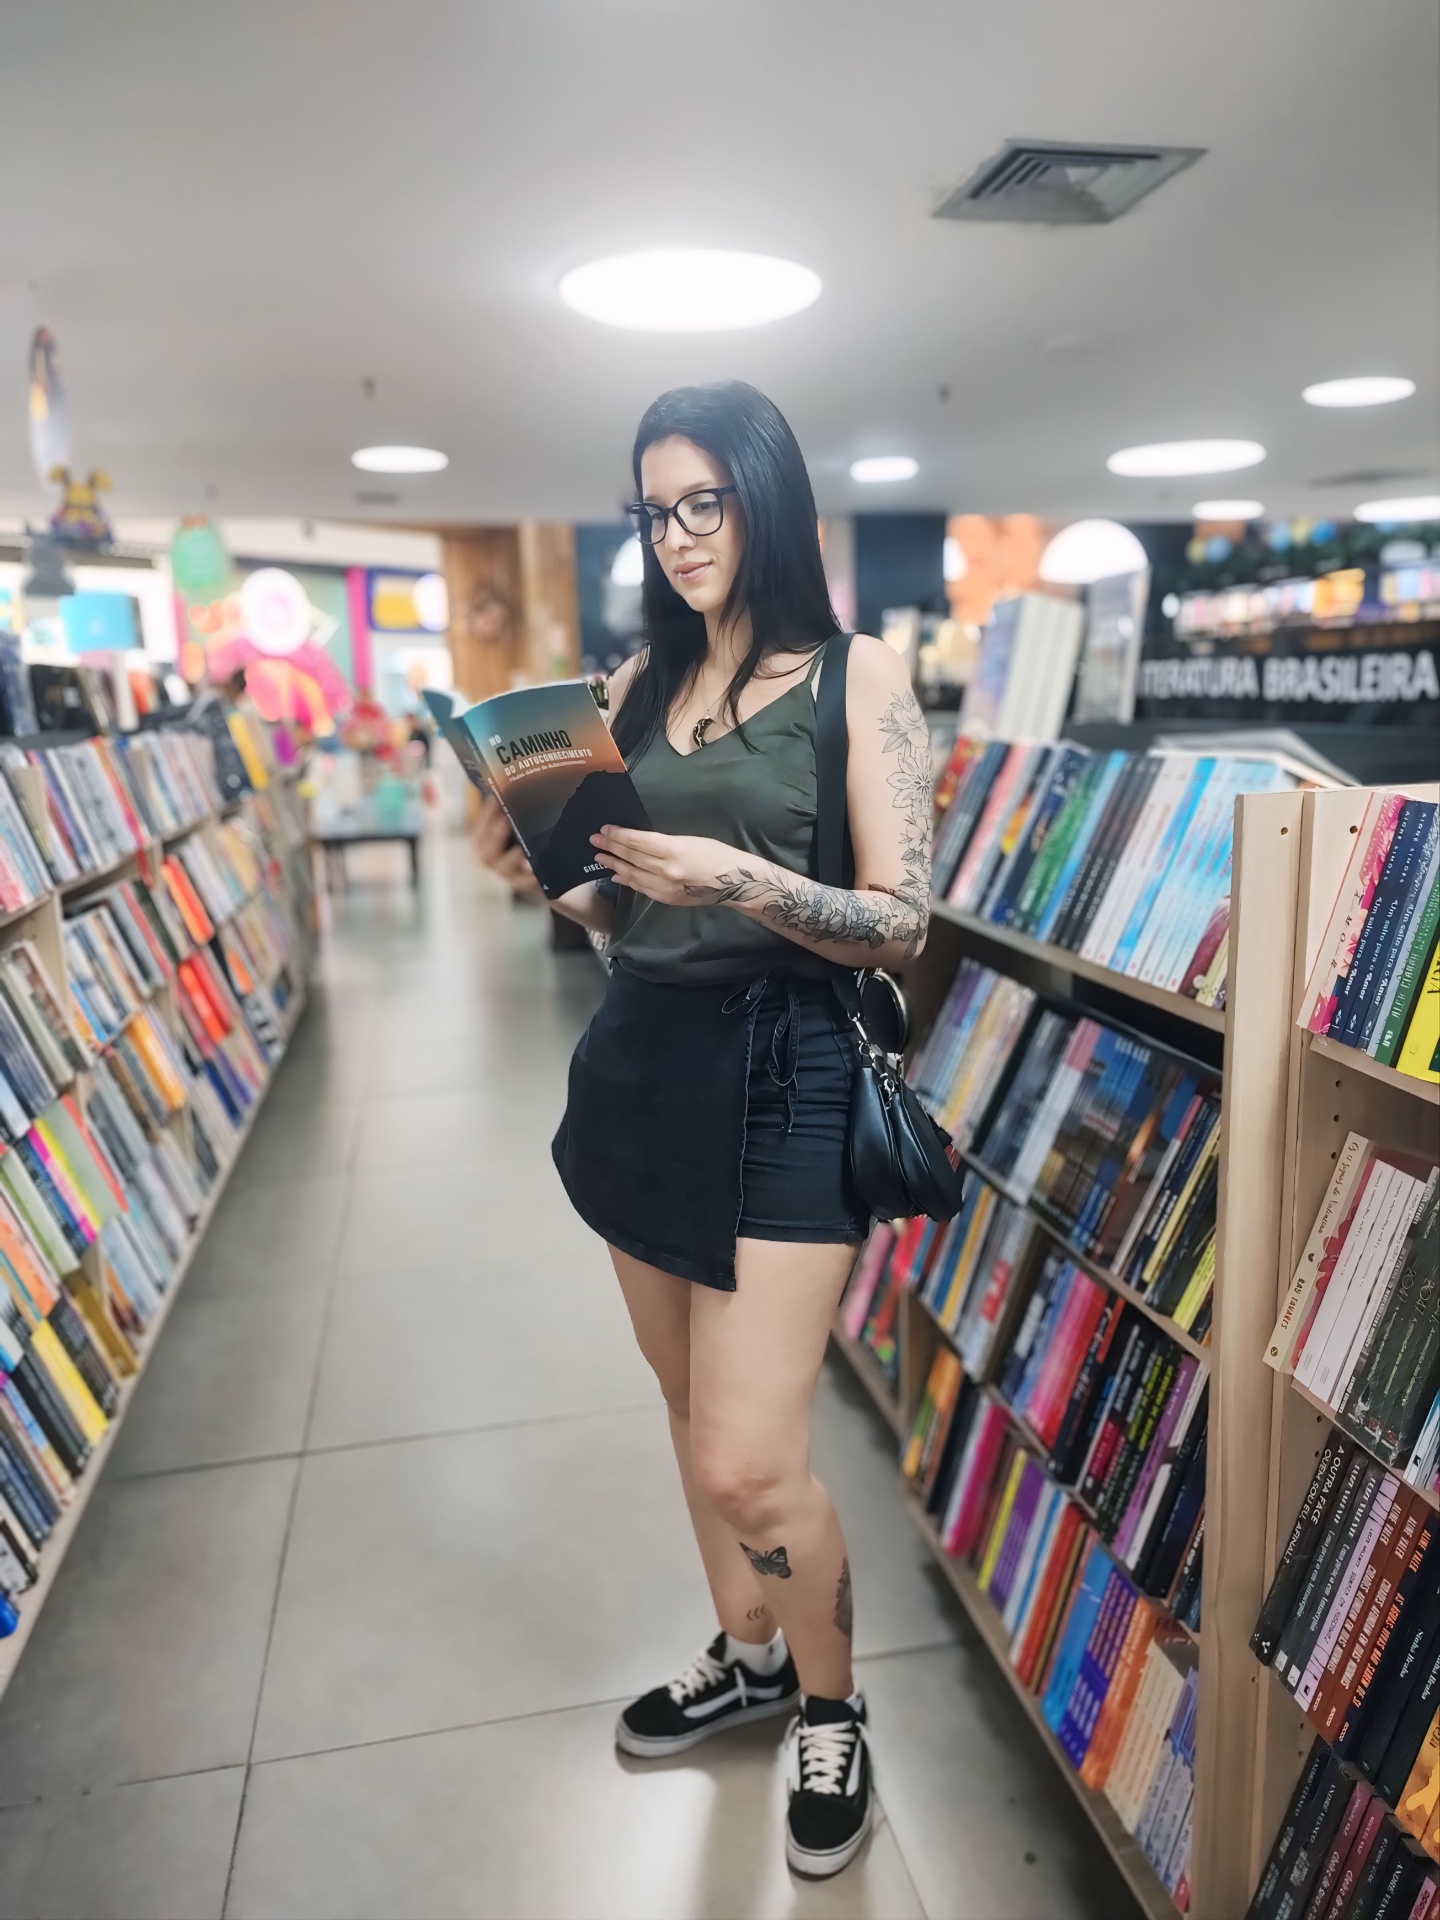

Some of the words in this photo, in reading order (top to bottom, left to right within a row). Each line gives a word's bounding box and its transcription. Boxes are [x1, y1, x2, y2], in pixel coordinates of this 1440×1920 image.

[1263, 650, 1439, 702] BRASILEIRA
[489, 734, 502, 747] NO
[496, 730, 572, 765] CAMINHO
[504, 766, 516, 776] DO
[518, 749, 593, 770] AUTOCONHECIMENTO
[583, 863, 608, 873] GISEL
[1371, 895, 1382, 914] Um
[1386, 898, 1398, 918] Um
[1402, 903, 1414, 923] Um
[1363, 916, 1375, 938] salto
[1378, 919, 1391, 941] salto
[1394, 923, 1407, 946] salto
[1355, 938, 1366, 958] para
[1370, 942, 1382, 962] para
[1386, 947, 1398, 968] para
[1343, 967, 1357, 996] Amor
[1358, 971, 1373, 1000] Amor
[1373, 977, 1388, 1007] Amor
[1294, 1277, 1305, 1294] RAY
[1395, 1266, 1416, 1303] 2047
[1413, 1277, 1435, 1315] 2047
[1280, 1296, 1297, 1329] TAVARES
[1337, 1444, 1345, 1455] A
[1321, 1455, 1341, 1494] OUTRA
[1306, 1480, 1319, 1504] SOU
[1299, 1502, 1310, 1520] EU,
[1310, 1495, 1325, 1524] FACE
[1388, 1502, 1402, 1524] ALINE
[1379, 1522, 1393, 1545] VALEK
[1403, 1515, 1417, 1538] ALINE
[1282, 1520, 1303, 1564] AFINAL?
[1394, 1536, 1408, 1559] VALEK
[1417, 1528, 1431, 1551] ALINE
[1185, 1547, 1196, 1566] dia
[1408, 1549, 1422, 1573] VALEK
[1359, 1564, 1376, 1593] CIDADES
[1374, 1578, 1391, 1607] CIDADES
[1394, 1591, 1405, 1605] AS
[1347, 1589, 1366, 1622] AFUNDAM
[1343, 1618, 1354, 1631] EM
[1362, 1604, 1380, 1636] AFUNDAM
[1376, 1603, 1401, 1651] ÁGUAS-VIVAS
[1337, 1627, 1350, 1647] DIAS
[1358, 1632, 1368, 1646] EM
[1326, 1643, 1343, 1674] NORMAIS
[1351, 1642, 1364, 1662] DIAS
[1370, 1647, 1382, 1666] NÃO
[1339, 1658, 1357, 1689] NORMAIS
[1360, 1662, 1375, 1688] SABEM
[1351, 1695, 1361, 1708] SI
[1355, 1685, 1365, 1698] DE
